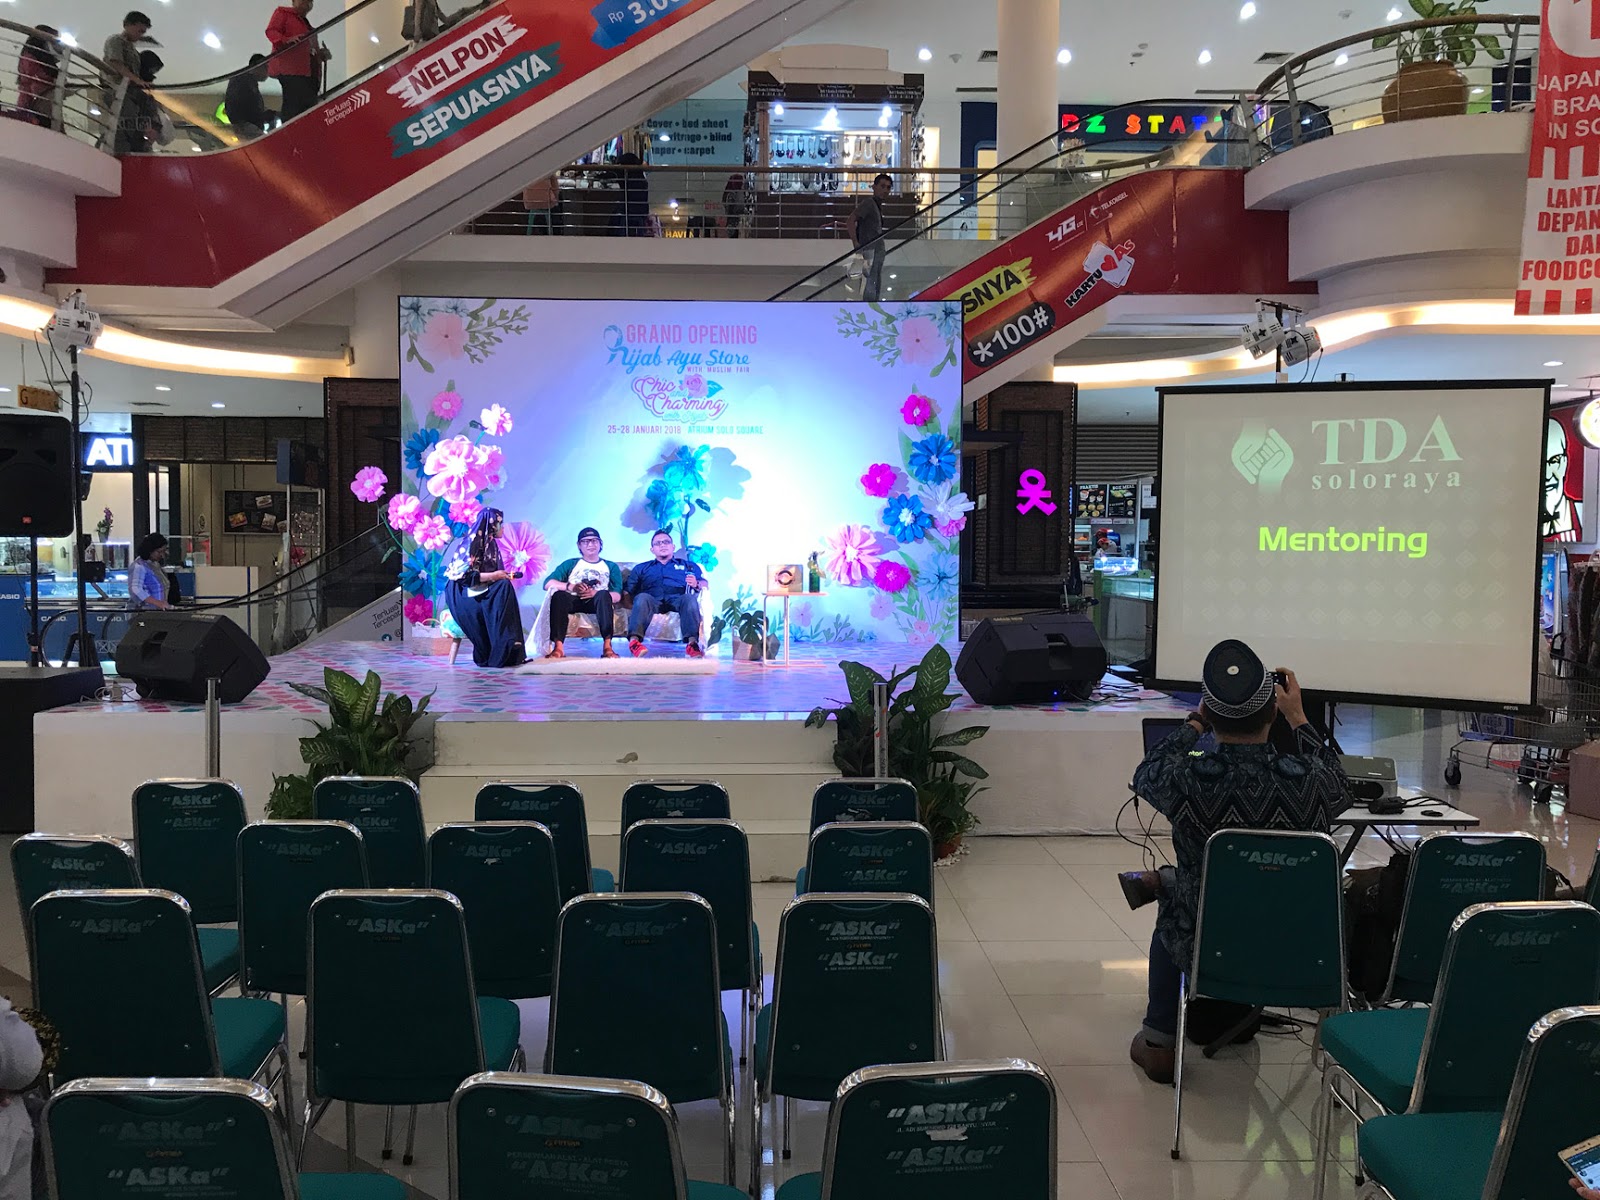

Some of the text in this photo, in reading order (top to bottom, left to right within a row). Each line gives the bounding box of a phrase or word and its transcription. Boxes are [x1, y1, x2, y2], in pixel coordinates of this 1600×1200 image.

[608, 0, 681, 24] Rp 3.0
[407, 26, 507, 96] NELPON
[324, 99, 352, 118] Terluas
[406, 53, 552, 147] SEPUASNYA
[324, 106, 354, 126] Tercepat
[1062, 114, 1222, 134] DZ STAT
[709, 132, 732, 141] blind
[1548, 122, 1568, 139] IN
[1045, 215, 1076, 243] 4G
[960, 269, 1022, 315] SNYA
[1065, 268, 1103, 307] KARTU
[626, 324, 758, 344] GRAND OPENING
[667, 350, 703, 375] Ayu
[705, 350, 751, 366] Store
[634, 377, 676, 400] Chic
[646, 392, 726, 417] Charming
[608, 425, 630, 434] 25-28
[633, 425, 662, 434] JANUARI
[665, 425, 681, 434] 2018
[688, 426, 714, 434] ATRIUM
[1311, 415, 1463, 465] TDA
[1311, 468, 1461, 493] soloraya
[1259, 527, 1428, 558] Mentoring
[372, 603, 399, 621] Terluas
